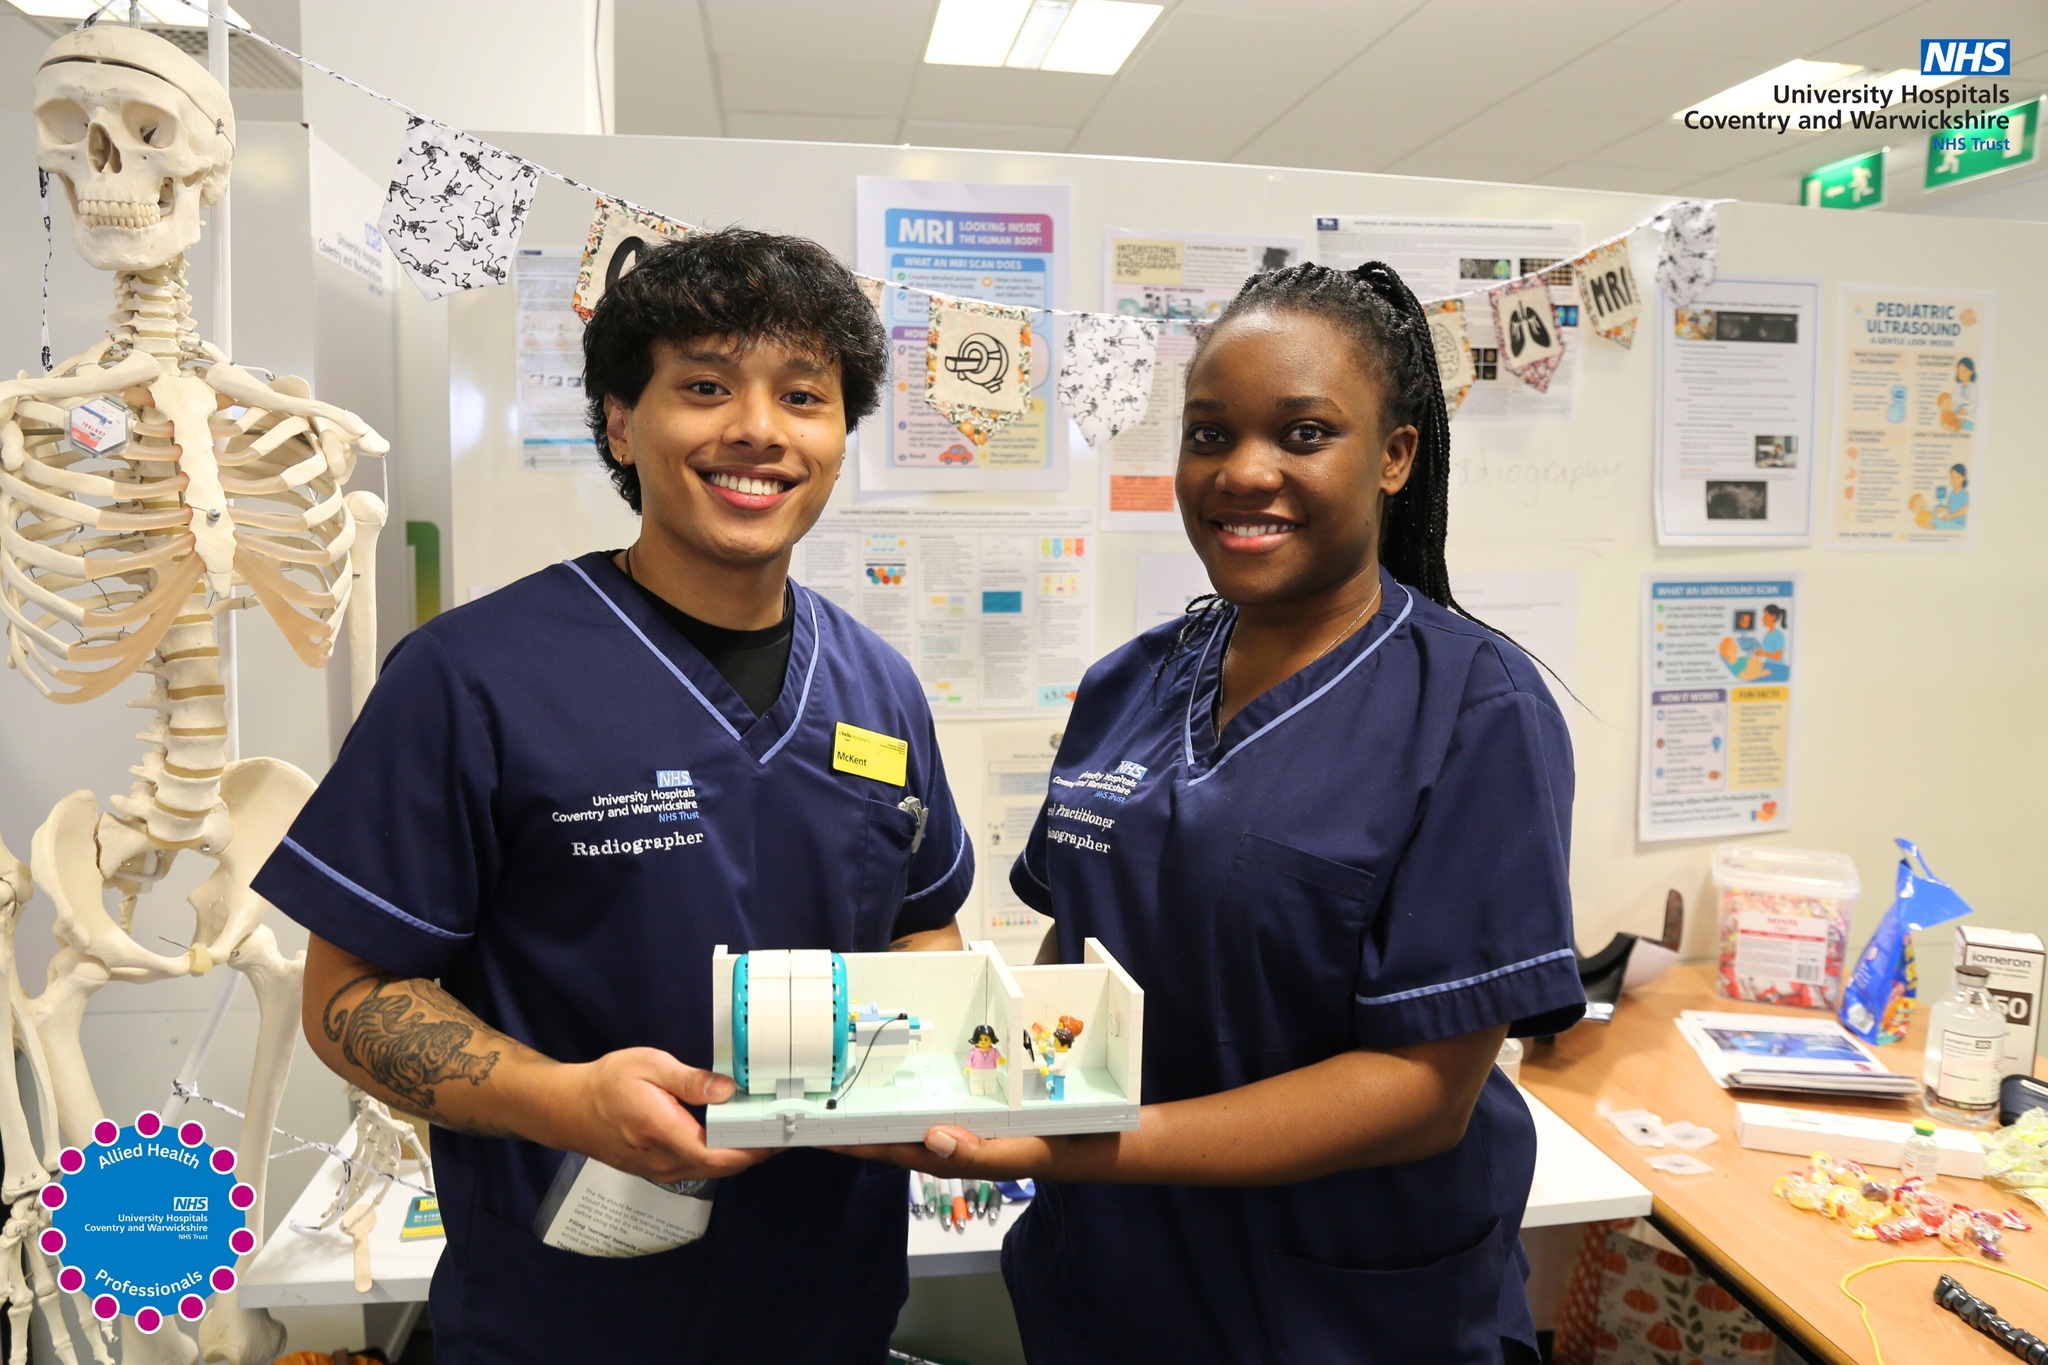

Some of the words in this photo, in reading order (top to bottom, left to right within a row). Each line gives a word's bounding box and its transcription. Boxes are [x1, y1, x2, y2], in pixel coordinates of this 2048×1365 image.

[898, 217, 954, 245] MRI
[959, 221, 1006, 233] LOOKING
[1007, 222, 1042, 234] INSIDE
[959, 234, 978, 245] THE
[979, 235, 1013, 246] HUMAN
[1013, 236, 1042, 246] BODY!
[903, 256, 932, 267] WHAT
[933, 258, 947, 268] AN
[949, 258, 968, 269] MRI
[968, 259, 994, 270] SCAN
[995, 260, 1022, 271] DOES
[1590, 266, 1632, 318] MRI
[1876, 302, 1955, 320] PEDIATRIC
[1867, 320, 1961, 336] ULTRASOUND
[1454, 447, 1621, 508] adiography
[1658, 586, 1684, 596] WHAT
[1686, 587, 1699, 595] AN
[1701, 586, 1756, 596] ULTRASOUND
[1757, 585, 1779, 595] SCAN
[1661, 693, 1680, 702] HOW
[836, 751, 867, 767] McKent
[658, 770, 692, 788] NHS
[1116, 761, 1147, 780] NHS
[592, 791, 648, 807] University
[650, 787, 696, 803] Hospitals
[1108, 791, 1126, 804] Trust
[552, 808, 605, 823] Coventry
[607, 804, 629, 818] and
[631, 799, 698, 815] Warwickshire
[658, 812, 678, 823] NHS
[678, 810, 700, 821] Trust
[571, 831, 704, 856] Radiographer
[1972, 951, 2032, 968] iomeron
[1994, 994, 2029, 1020] 50
